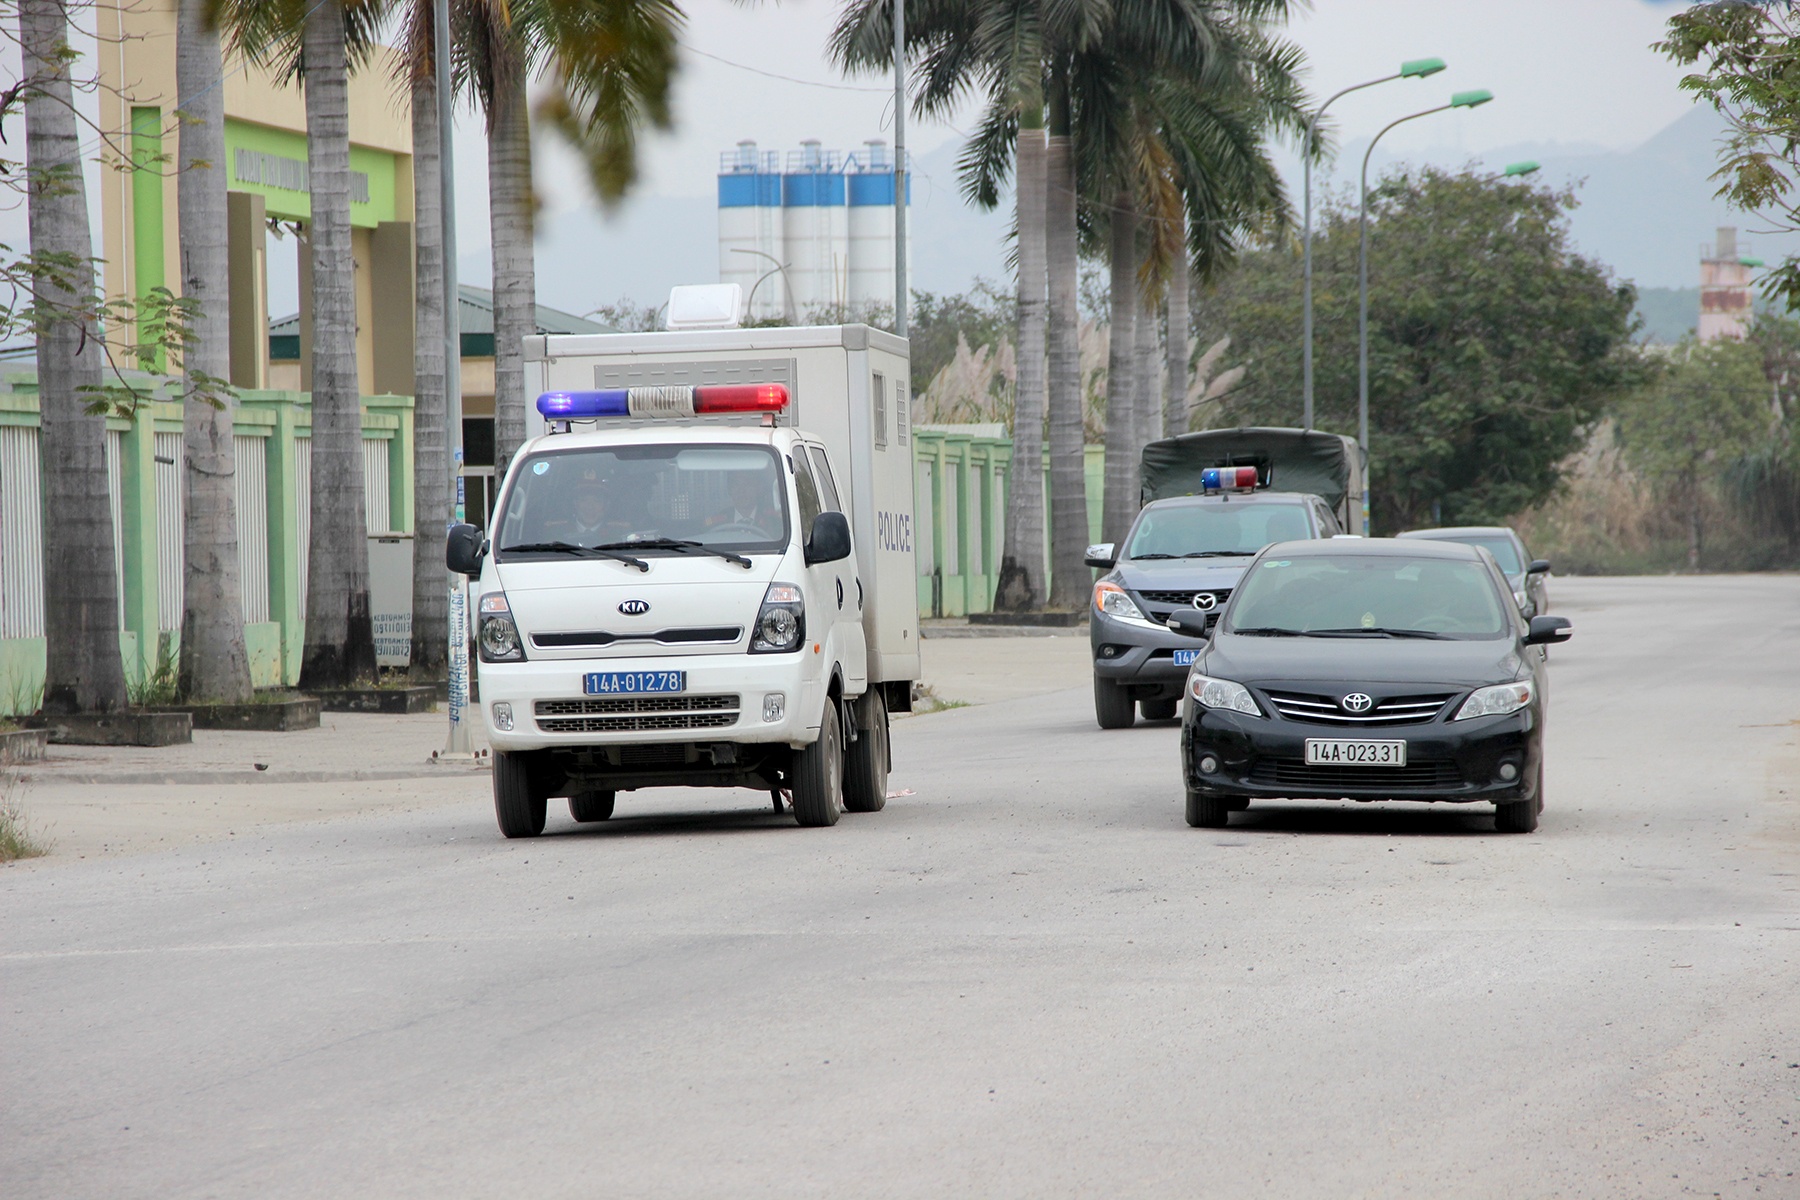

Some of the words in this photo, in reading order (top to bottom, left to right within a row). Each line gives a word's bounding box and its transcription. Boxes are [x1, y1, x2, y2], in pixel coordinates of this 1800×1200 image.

[878, 511, 911, 552] POLICE
[622, 602, 646, 613] KIA
[591, 673, 679, 692] 14A-012.78
[1313, 743, 1400, 762] 14A-023.31
